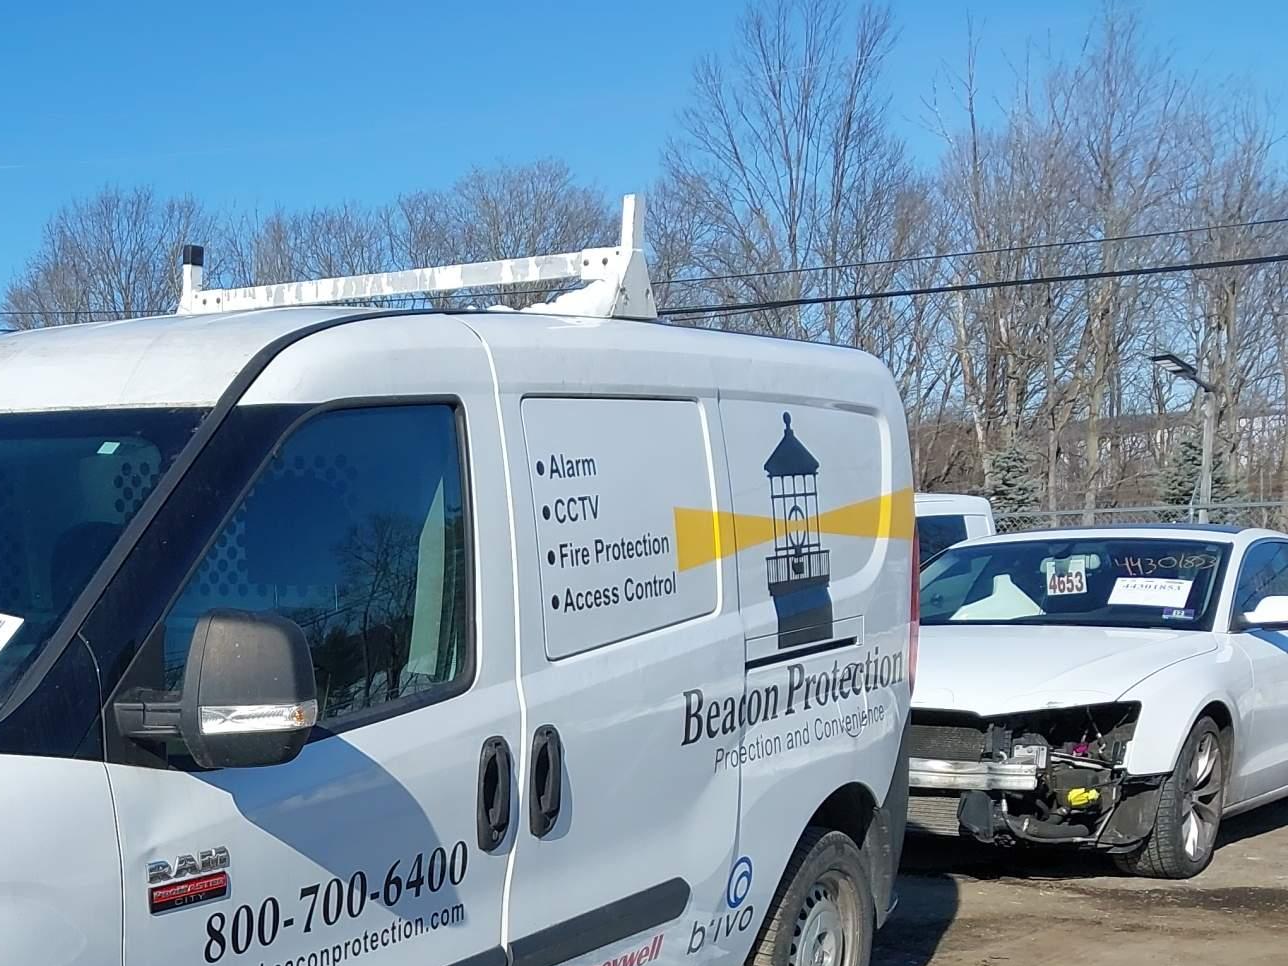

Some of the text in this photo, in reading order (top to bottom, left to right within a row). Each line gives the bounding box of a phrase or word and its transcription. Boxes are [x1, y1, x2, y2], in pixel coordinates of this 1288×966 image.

[549, 453, 597, 480] Alarm
[554, 494, 600, 524] CCTV
[558, 532, 670, 569] Fire Protection
[564, 571, 677, 613] Access Control
[1048, 570, 1085, 594] 4653
[681, 645, 903, 746] Beacon Protection
[714, 703, 885, 774] Proection and Convenience
[145, 845, 231, 884] RAM
[174, 893, 205, 906] CITY
[203, 840, 468, 964] 800-700-6400
